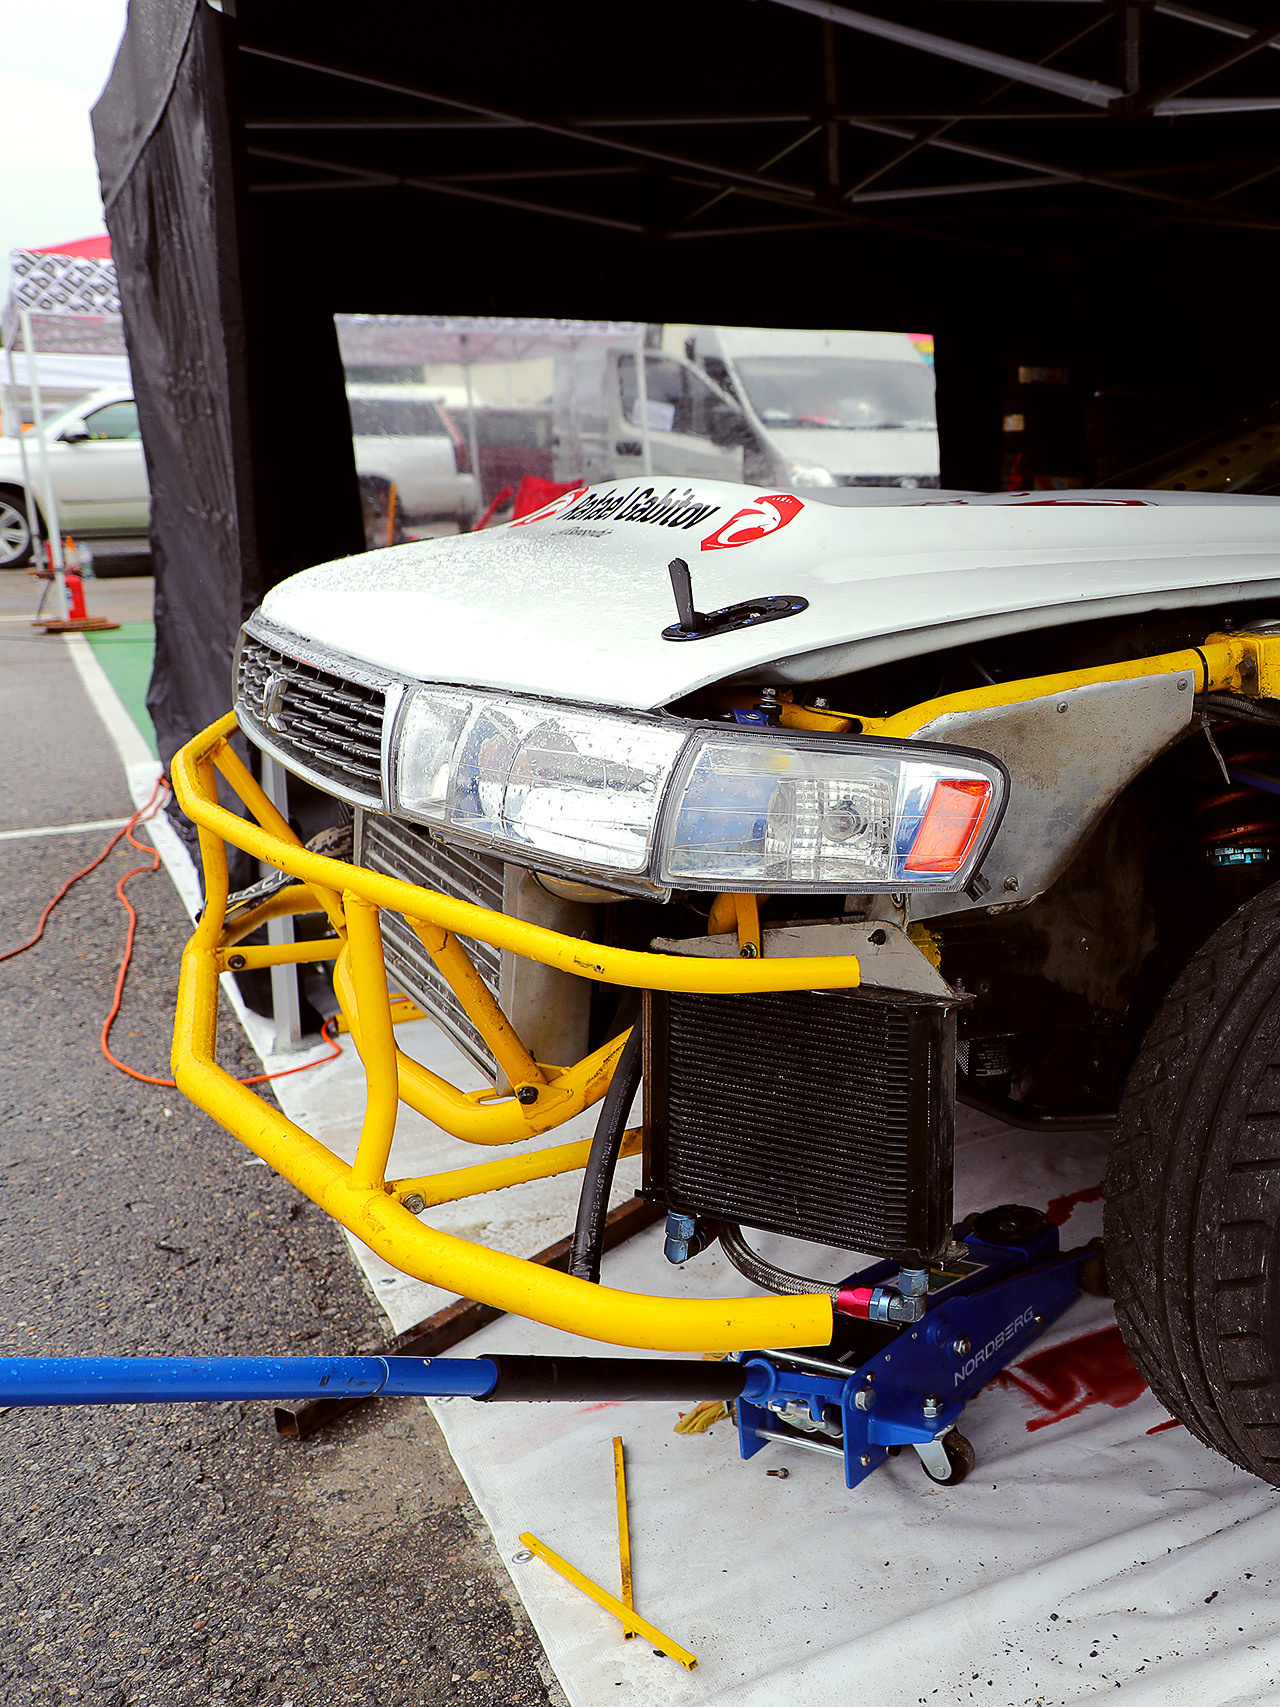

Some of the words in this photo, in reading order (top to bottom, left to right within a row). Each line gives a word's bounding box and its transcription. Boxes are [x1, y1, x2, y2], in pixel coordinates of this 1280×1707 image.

[556, 486, 640, 521] Rafael
[613, 488, 721, 530] Gabitov
[601, 1143, 612, 1166] ITALY
[953, 1305, 1034, 1387] NORDBERG
